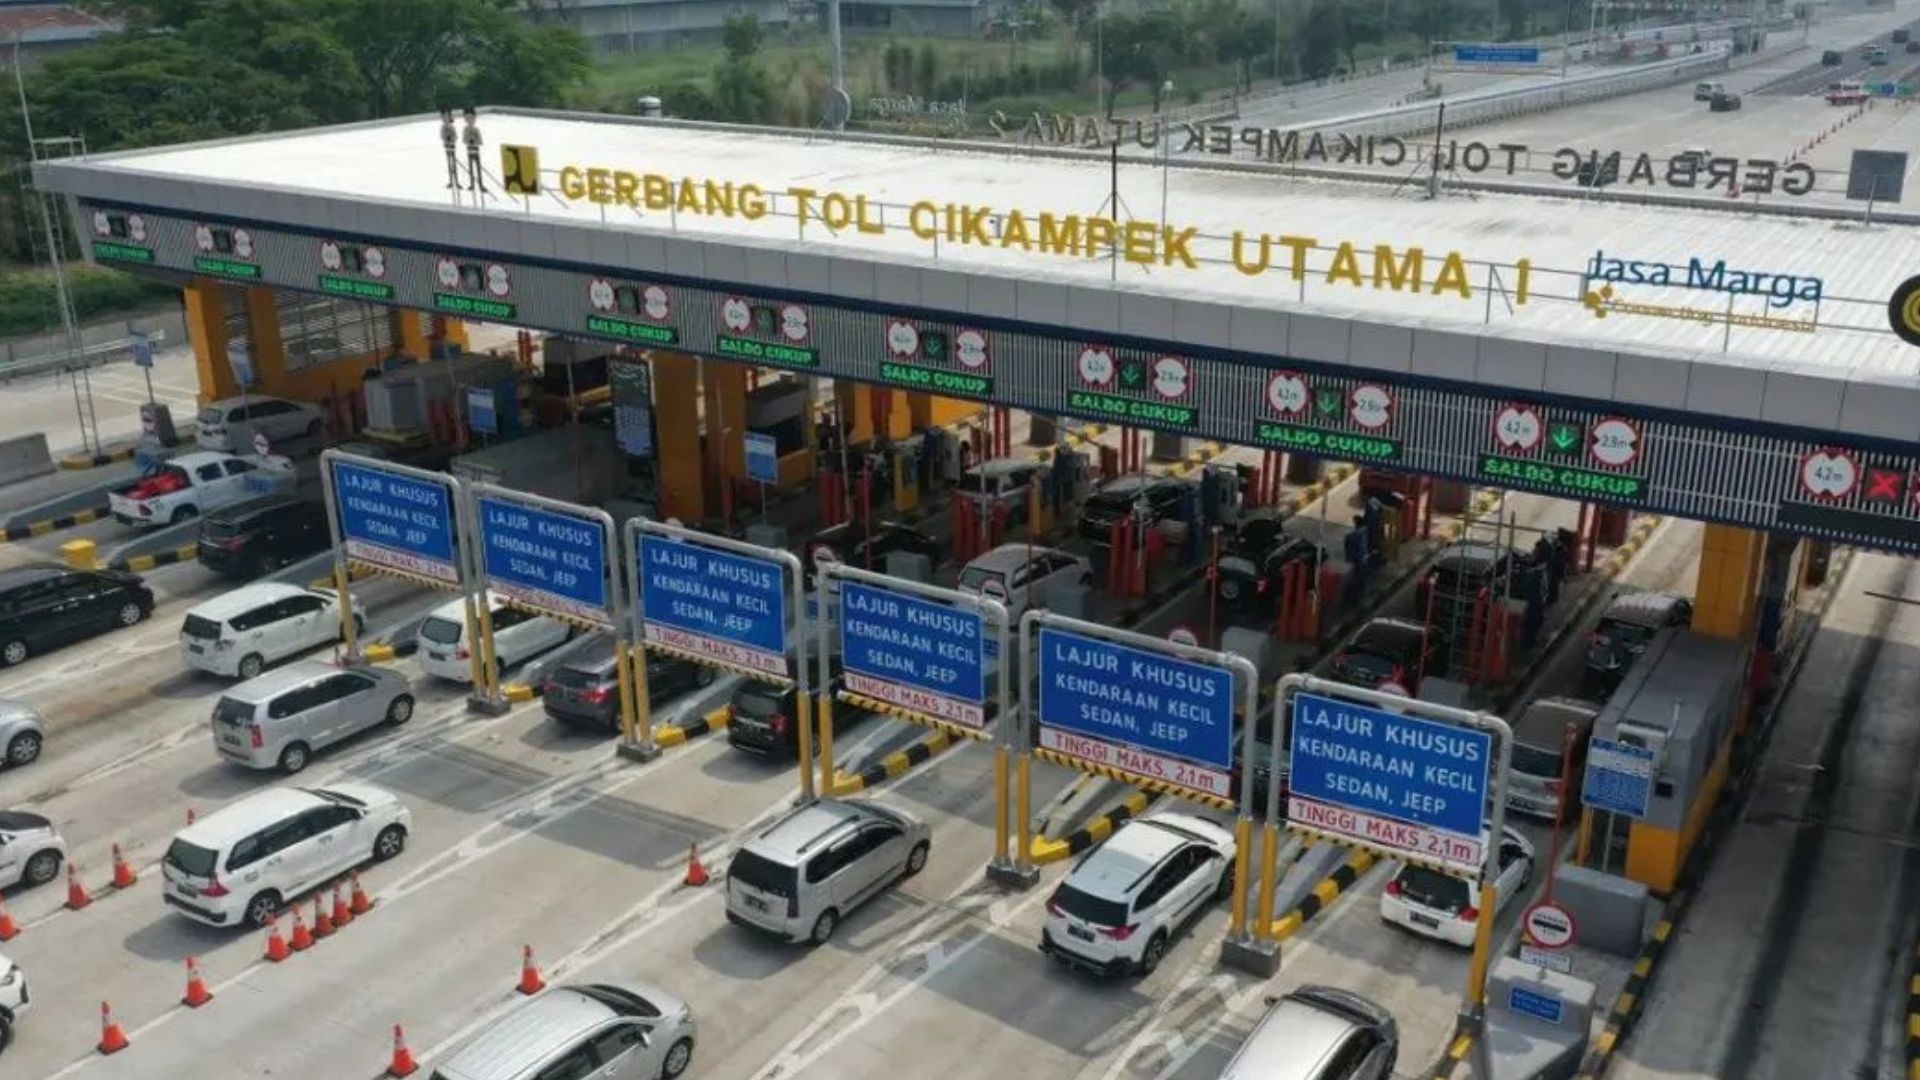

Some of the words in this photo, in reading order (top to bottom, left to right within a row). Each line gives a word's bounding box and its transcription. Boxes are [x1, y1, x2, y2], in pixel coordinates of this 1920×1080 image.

[559, 165, 767, 220] GERBANG
[787, 187, 885, 235] TOL
[909, 201, 1198, 270] CIKAMPEK
[1231, 231, 1472, 299] UTAMA
[1586, 249, 1670, 286] Jasa
[1687, 257, 1823, 308] Marga
[719, 339, 762, 357] SALDO
[766, 347, 812, 365] CUKUP
[882, 363, 931, 383] SALDO
[933, 373, 987, 393] CUKUP
[1071, 393, 1126, 414] SALDO
[1130, 403, 1191, 424] CUKUP
[1260, 424, 1321, 446] SALDO
[1325, 435, 1394, 456] CUKUP
[1483, 458, 1555, 483] SALDO
[1560, 469, 1639, 496] CUKUP
[651, 549, 698, 571] LAJUR
[708, 560, 771, 590] KHUSUS
[652, 573, 729, 603] KENDARAAN
[736, 594, 771, 615] KECIL
[724, 615, 753, 632] JEEP
[847, 592, 899, 618] LAJUR
[907, 607, 975, 638] KHUSUS
[655, 627, 691, 646] TINGGI
[846, 620, 932, 653] KENDARAAN
[938, 642, 977, 665] KECIL
[925, 665, 958, 683] JEEP
[1055, 643, 1119, 673] LAJUR
[1131, 660, 1216, 698] KHUSUS
[851, 676, 895, 698] TINGGI
[1055, 674, 1159, 711] KENDARAAN
[1167, 700, 1215, 725] KECIL
[1055, 734, 1108, 760] TINGGI
[1150, 722, 1188, 743] JEEP
[1302, 705, 1373, 737] LAJUR
[1385, 724, 1479, 762] KHUSUS
[1299, 736, 1415, 779] KENDARAAN
[1424, 765, 1477, 793] KECIL
[1297, 801, 1356, 830] TINGGI
[1400, 790, 1447, 815] JEEP
